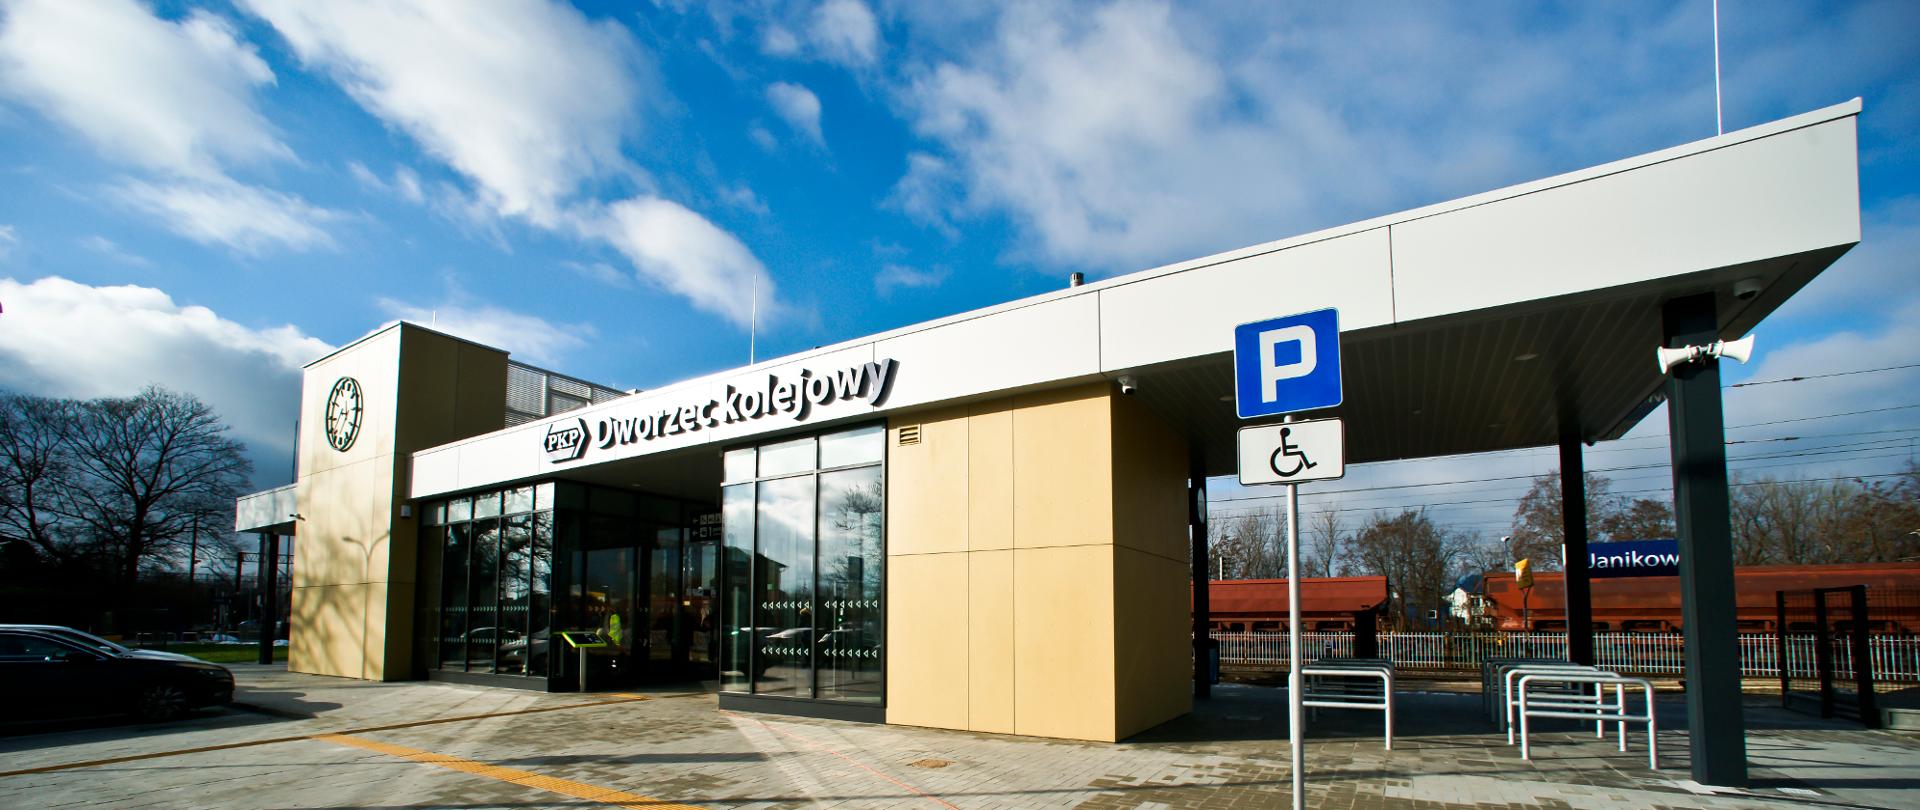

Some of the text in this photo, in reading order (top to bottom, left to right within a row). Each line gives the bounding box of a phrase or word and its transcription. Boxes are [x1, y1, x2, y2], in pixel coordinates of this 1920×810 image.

[1259, 325, 1317, 403] P
[547, 429, 579, 451] PKP
[597, 358, 900, 449] Dworzec kolejowy
